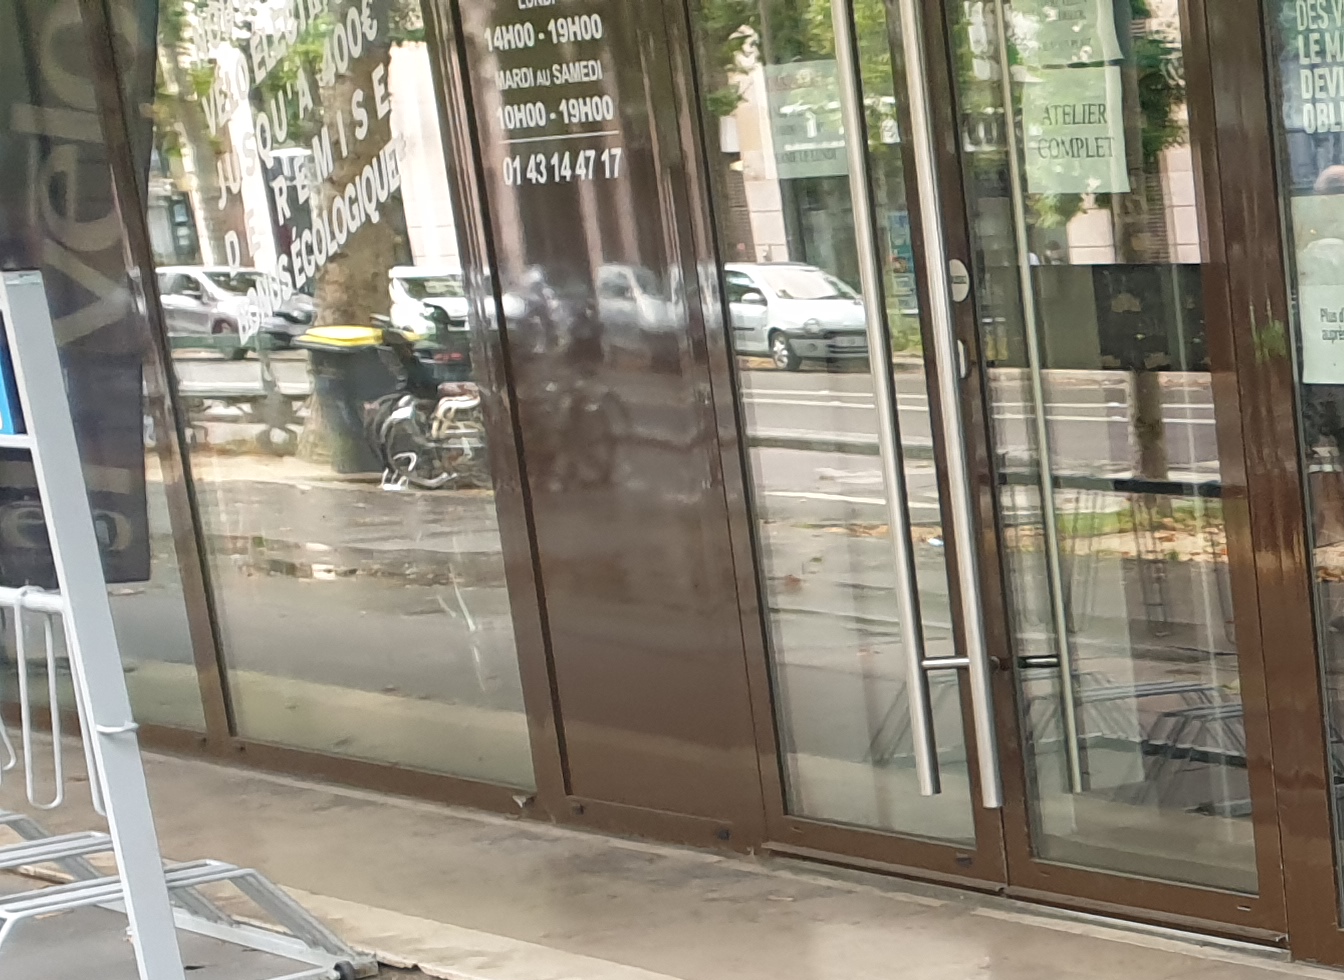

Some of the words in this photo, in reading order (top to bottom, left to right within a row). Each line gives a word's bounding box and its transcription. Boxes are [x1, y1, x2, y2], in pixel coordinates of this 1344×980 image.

[1296, 0, 1329, 30] DES
[484, 22, 535, 52] 14H00
[548, 14, 602, 44] 19H00
[1298, 33, 1321, 65] LE
[494, 67, 534, 91] MARDI
[536, 69, 551, 87] AU
[552, 60, 603, 85] SAMEDI
[497, 101, 546, 130] 10H00
[559, 94, 614, 124] 19H00
[1042, 103, 1108, 126] ATELIER
[272, 62, 393, 226] REMISE
[1038, 136, 1115, 159] COMPLET
[503, 155, 521, 186] 01
[526, 153, 547, 184] 43
[551, 151, 572, 182] 14
[575, 149, 595, 180] 47
[601, 147, 622, 178] 17
[1320, 307, 1337, 323] Plus
